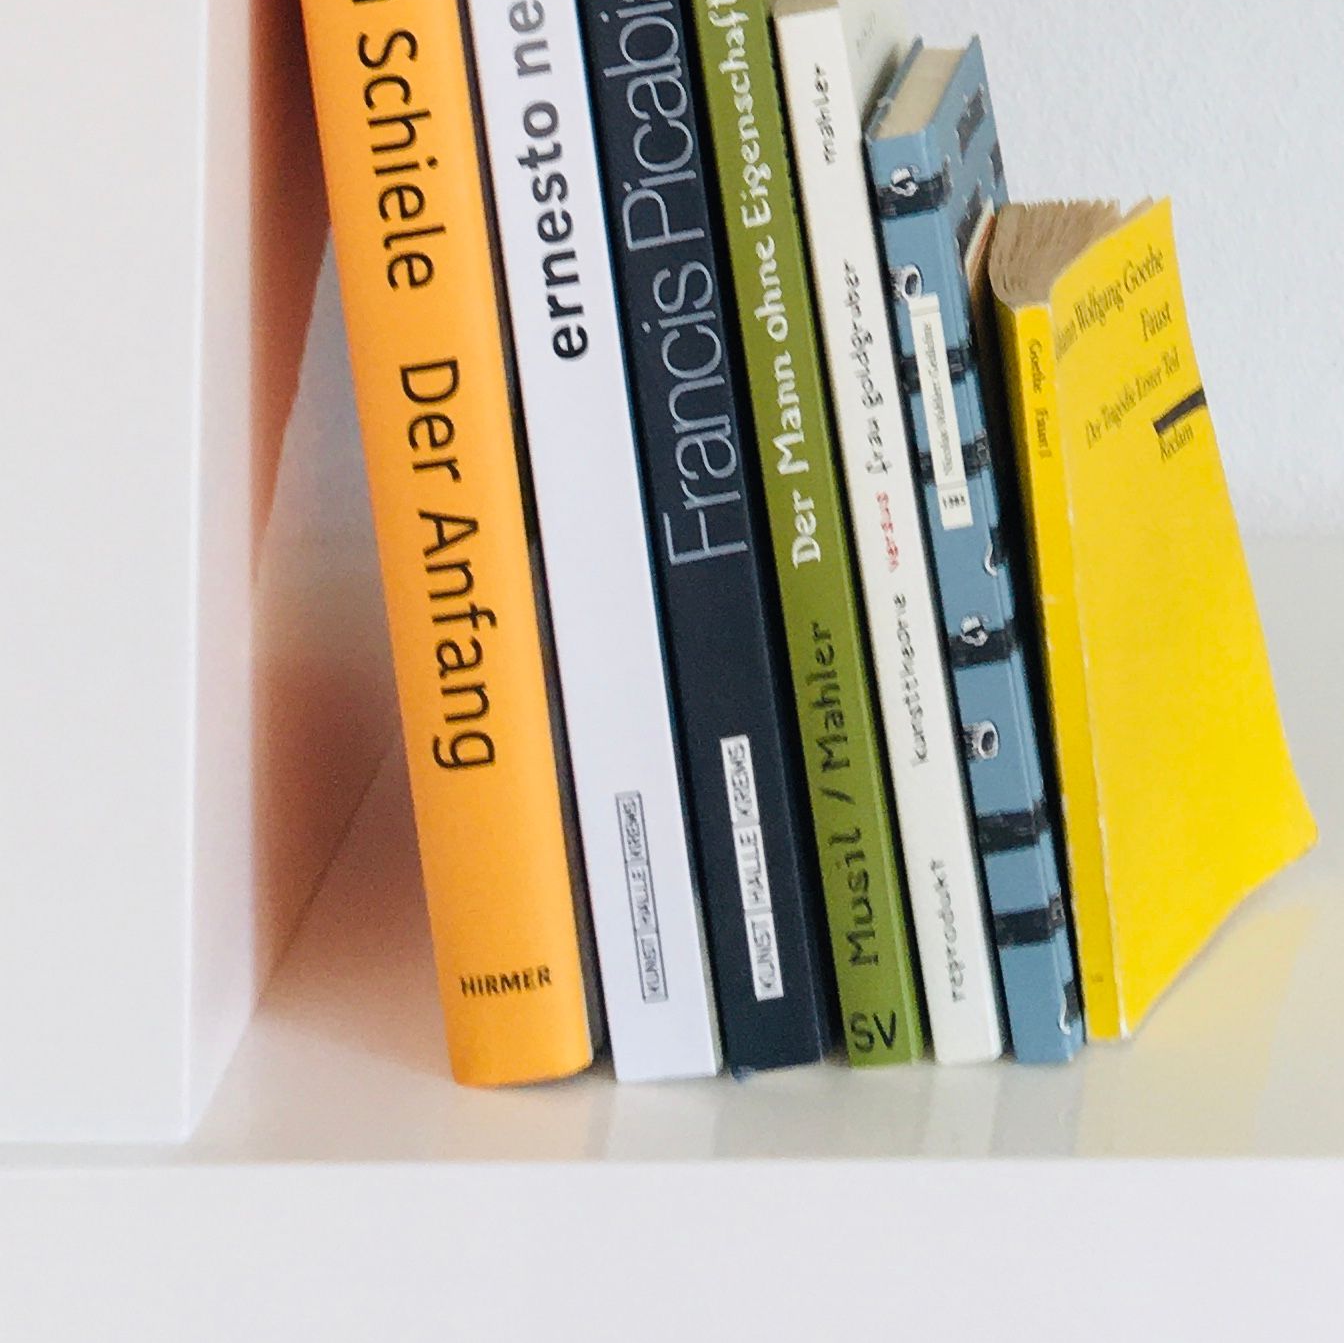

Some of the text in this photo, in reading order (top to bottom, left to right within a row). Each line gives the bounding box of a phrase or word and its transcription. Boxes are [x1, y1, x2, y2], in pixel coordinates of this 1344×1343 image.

[357, 26, 447, 291] Schiele
[812, 62, 838, 166] mahler
[517, 100, 590, 361] ernesto
[754, 235, 788, 343] ohne
[1074, 279, 1124, 337] Wolfgang
[1122, 242, 1164, 294] Goethe
[844, 258, 885, 410] goldgruber
[1139, 300, 1173, 343] Faust
[400, 357, 461, 484] Der
[642, 260, 749, 566] Francis
[774, 351, 810, 476] Mann
[865, 417, 892, 476] frau
[791, 489, 821, 571] Der
[417, 509, 496, 773] Anfang
[804, 621, 851, 773] Mahler
[827, 827, 879, 967] Musil
[460, 964, 552, 998] HIRMER
[851, 1010, 897, 1054] SV
